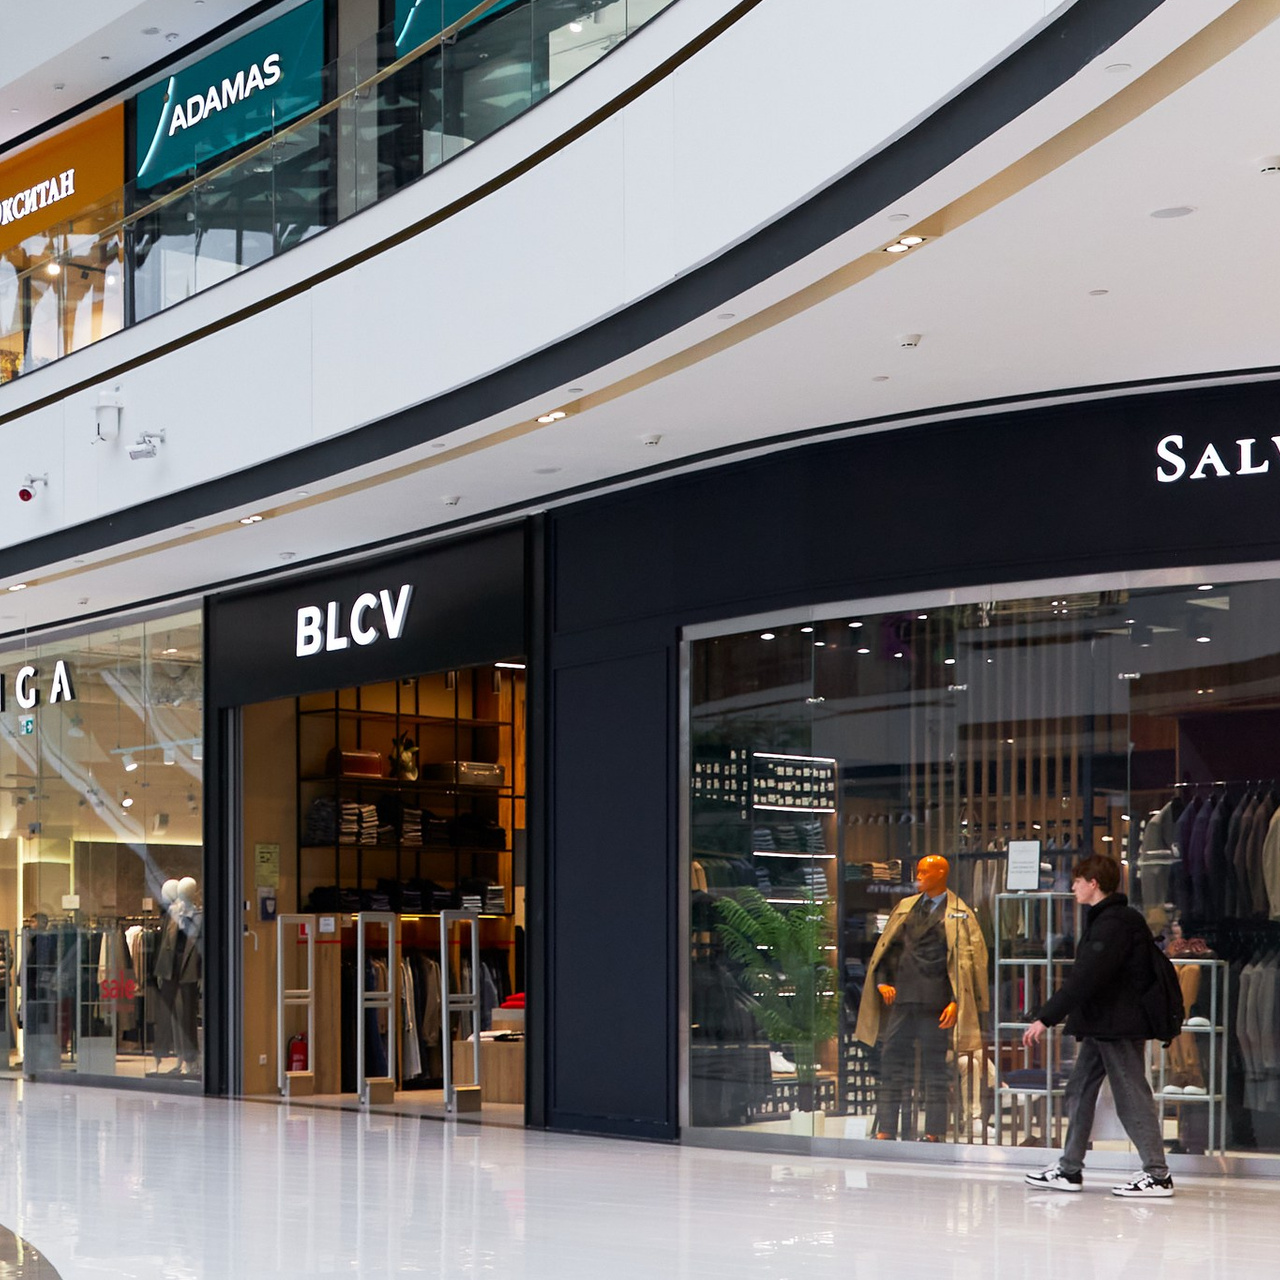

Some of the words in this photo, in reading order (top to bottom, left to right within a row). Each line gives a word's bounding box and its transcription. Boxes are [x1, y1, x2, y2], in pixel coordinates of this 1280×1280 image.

[168, 53, 281, 137] ADAMAS
[296, 584, 413, 658] BLCV
[101, 970, 136, 1000] sale
